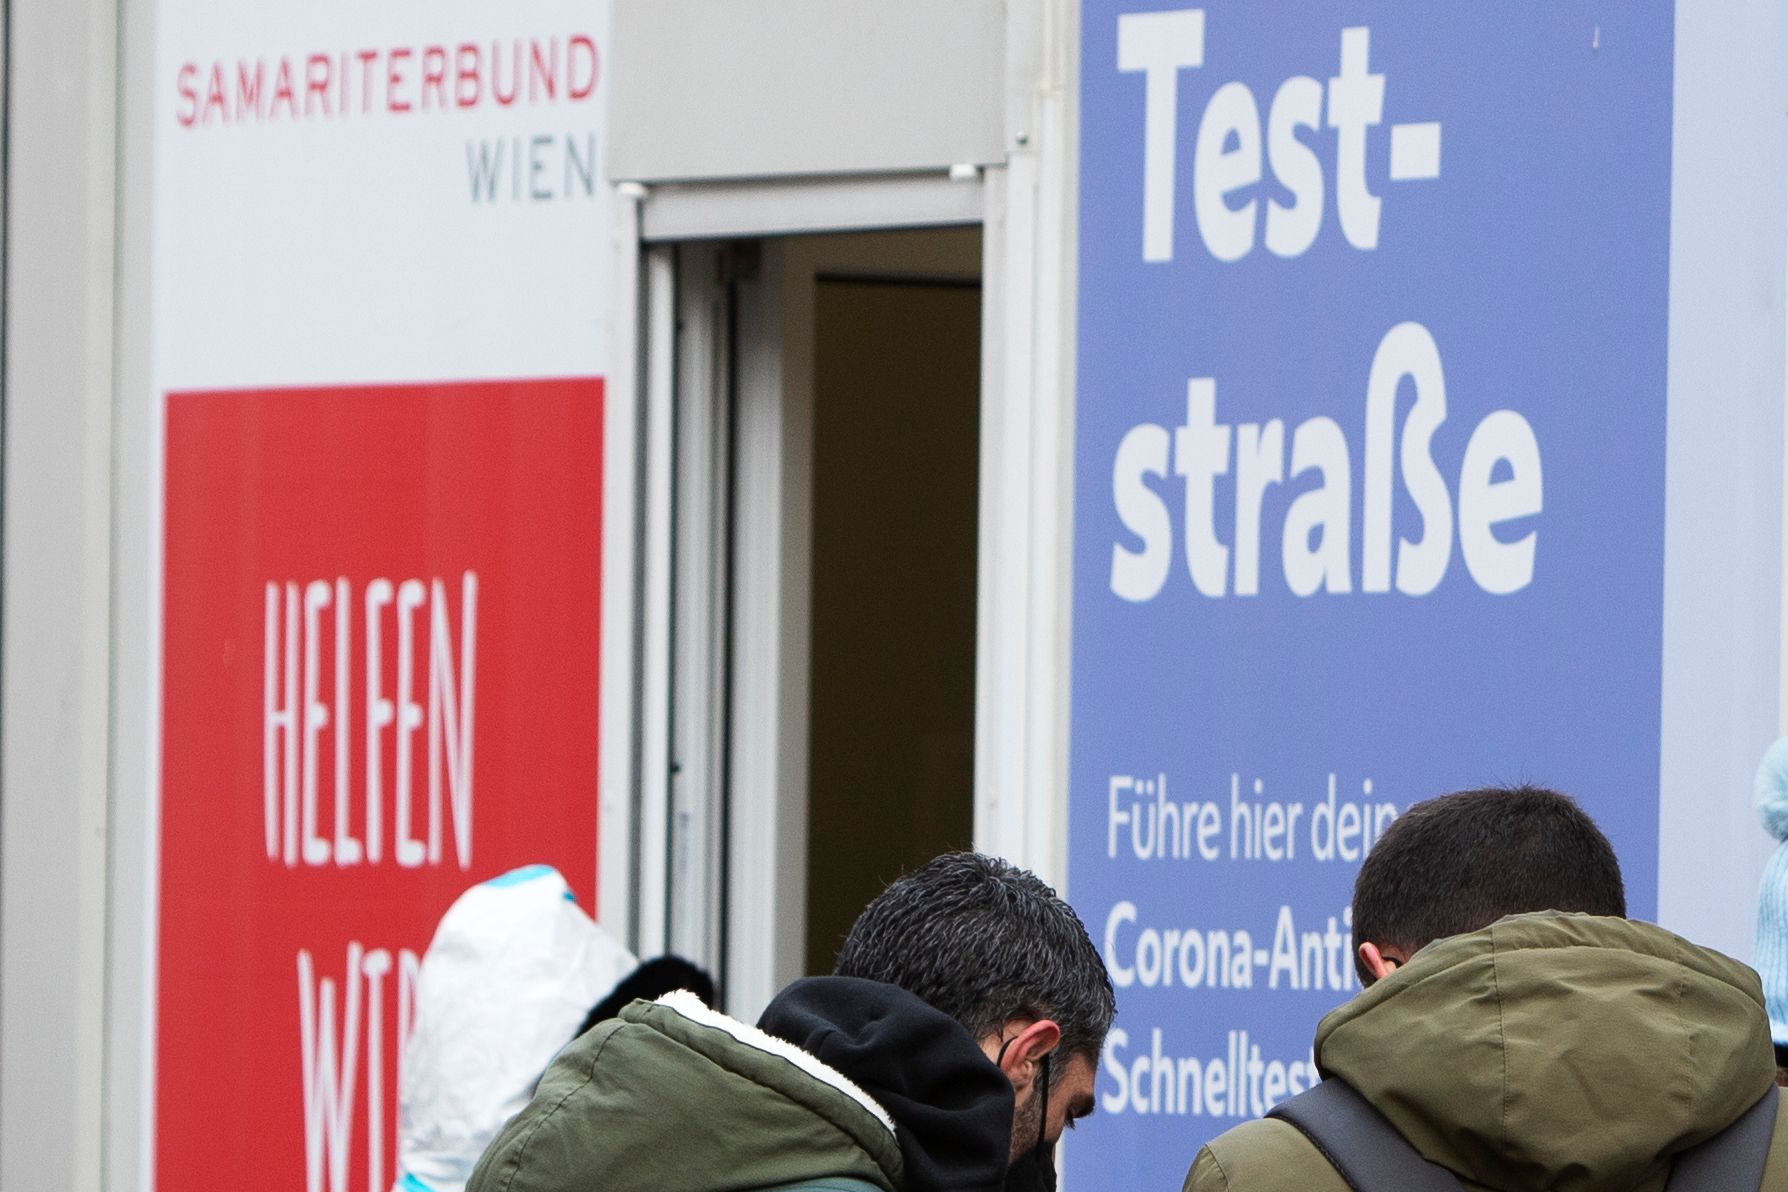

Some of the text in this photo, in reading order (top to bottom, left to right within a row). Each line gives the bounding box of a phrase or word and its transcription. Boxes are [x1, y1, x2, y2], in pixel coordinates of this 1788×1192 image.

[175, 34, 599, 129] SAMARITERBUND
[465, 131, 598, 204] WIEN
[1117, 9, 1441, 263] Test-
[1110, 321, 1544, 603] straße
[263, 569, 478, 871] HELFEN
[1108, 772, 1222, 861] Führe
[1230, 772, 1304, 861] hier
[1104, 900, 1358, 990] Corona-Anti
